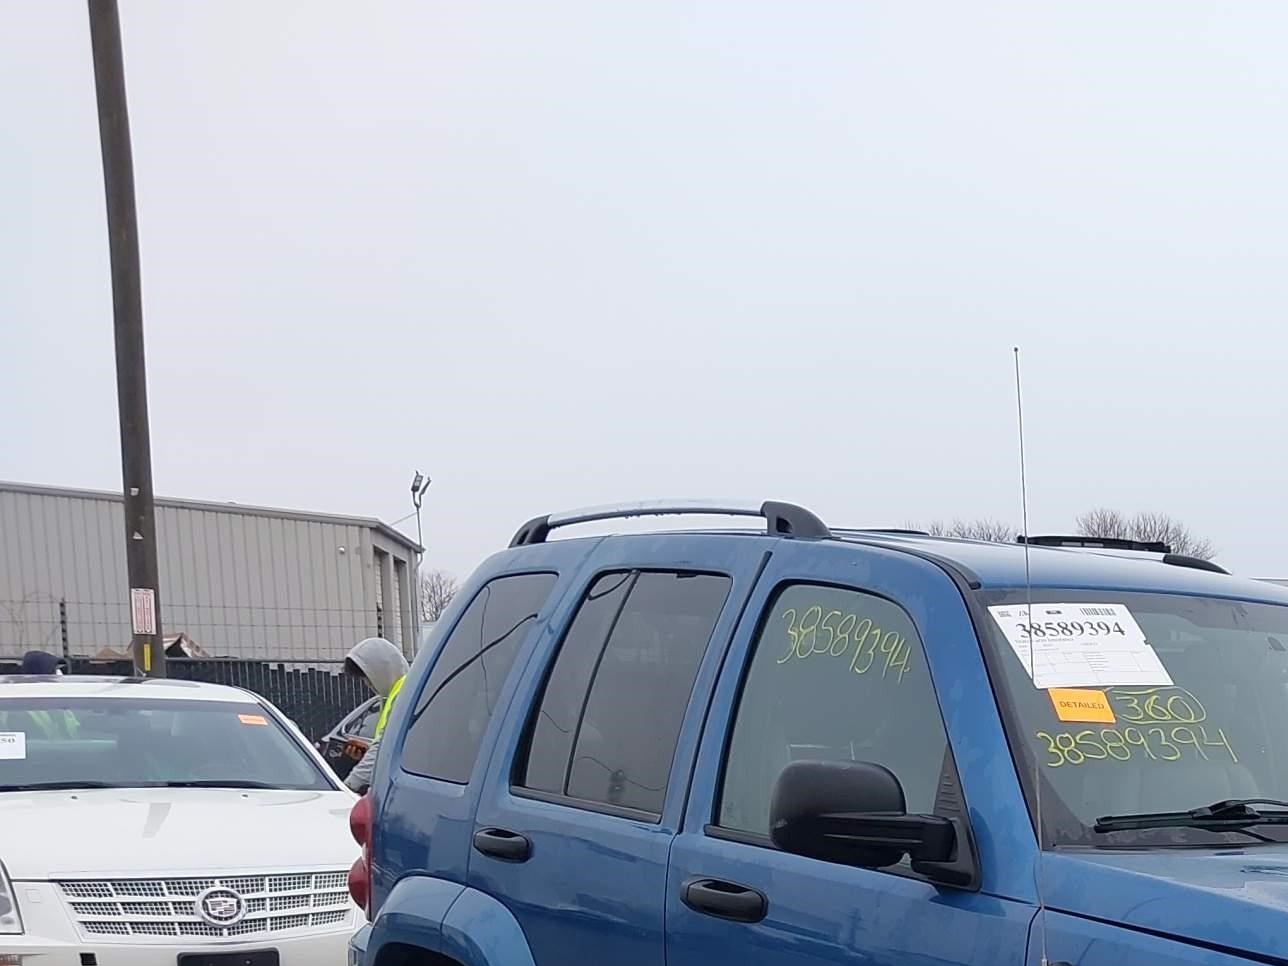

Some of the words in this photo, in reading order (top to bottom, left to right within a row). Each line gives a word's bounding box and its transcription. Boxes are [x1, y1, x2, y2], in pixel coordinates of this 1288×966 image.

[1016, 621, 1126, 638] 38589394
[777, 606, 911, 683] 38589394
[1060, 700, 1105, 710] DETAILED
[1115, 694, 1196, 721] 360
[1037, 727, 1238, 767] 38589394
